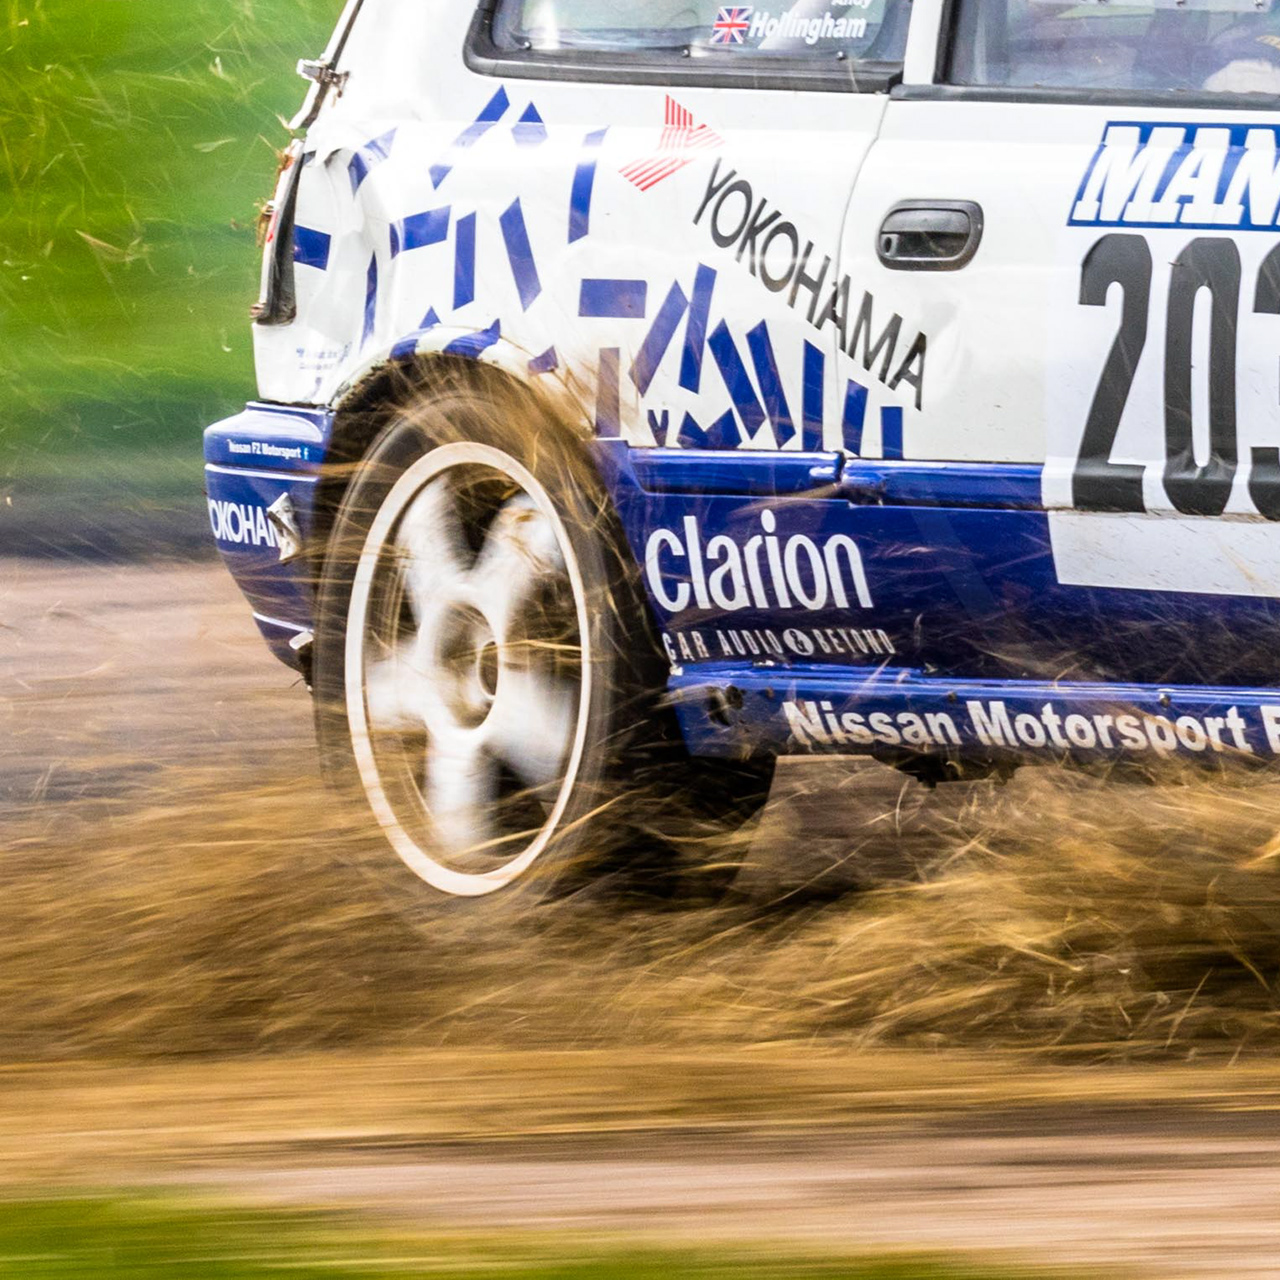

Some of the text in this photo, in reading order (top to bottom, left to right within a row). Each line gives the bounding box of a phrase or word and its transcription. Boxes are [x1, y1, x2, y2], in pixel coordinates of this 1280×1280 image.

[748, 12, 867, 45] Hollingham
[692, 157, 929, 412] YOKOHAMA
[662, 621, 710, 661] CAR
[715, 629, 783, 656] AUDIO
[812, 628, 896, 654] BEYOND
[783, 699, 957, 746] Nissan
[966, 700, 1253, 758] Motorsport
